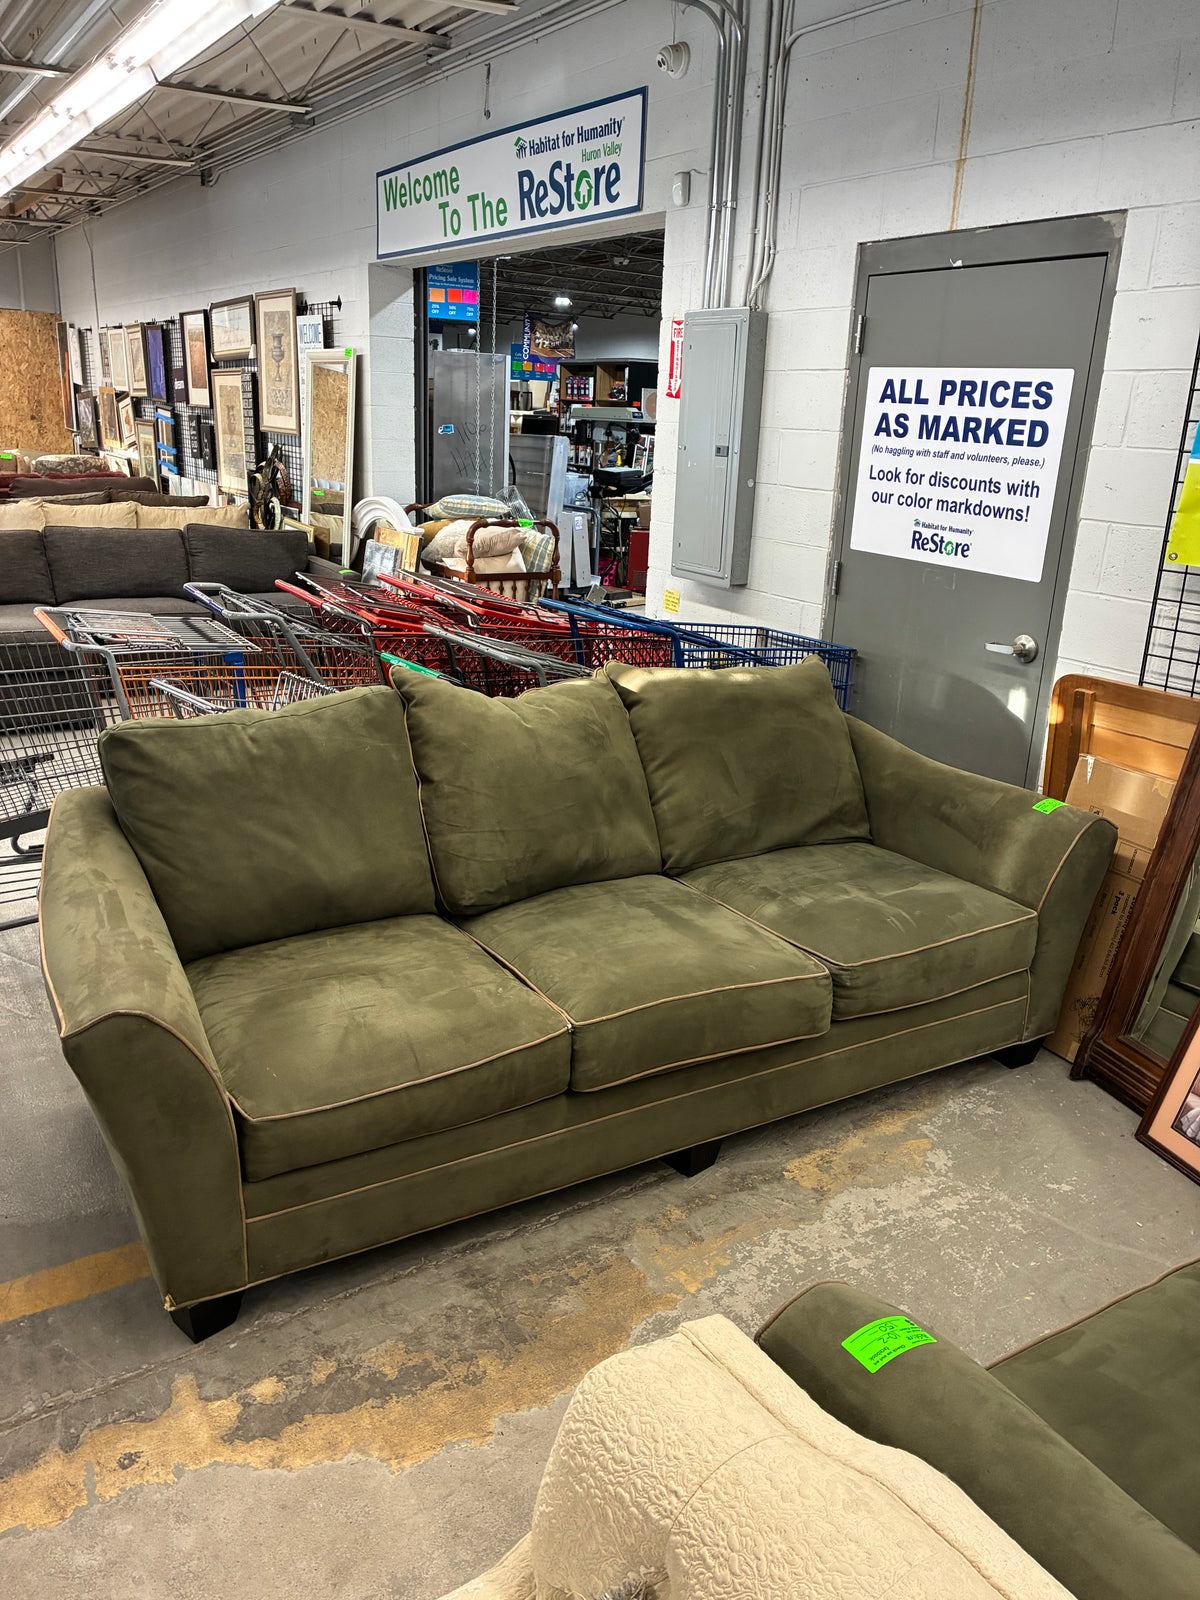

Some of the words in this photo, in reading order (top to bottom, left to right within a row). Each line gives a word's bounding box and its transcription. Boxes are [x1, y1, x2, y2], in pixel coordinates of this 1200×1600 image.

[528, 132, 561, 157] Habitat
[562, 130, 574, 146] for
[576, 117, 624, 144] Humanity
[581, 146, 601, 163] Huron
[602, 142, 623, 158] Valley
[383, 165, 460, 212] Welcome
[518, 160, 622, 220] ReStore
[438, 201, 462, 237] To
[467, 192, 508, 232] The
[429, 274, 446, 282] Pricing
[522, 312, 531, 360] COMMUNITY
[878, 378, 929, 405] ALL
[938, 379, 1054, 410] PRICES
[874, 412, 910, 438] AS
[918, 414, 1050, 448] MARKED
[871, 444, 884, 455] (No
[885, 446, 914, 458] haggling
[916, 448, 932, 458] with
[932, 450, 950, 460] staff
[950, 452, 965, 460] and
[966, 452, 1010, 466] volunteers,
[1012, 456, 1046, 469] please.)
[869, 464, 902, 483] Look
[906, 468, 925, 485] for
[928, 471, 1001, 494] discounts
[1006, 480, 1040, 498] with
[872, 490, 894, 505] our
[897, 492, 933, 510] color
[936, 498, 1030, 522] markdowns!
[911, 530, 970, 558] ReStore
[921, 521, 940, 531] Habitat
[940, 524, 948, 532] for
[948, 525, 973, 536] Humanity
[1111, 896, 1121, 916] pack
